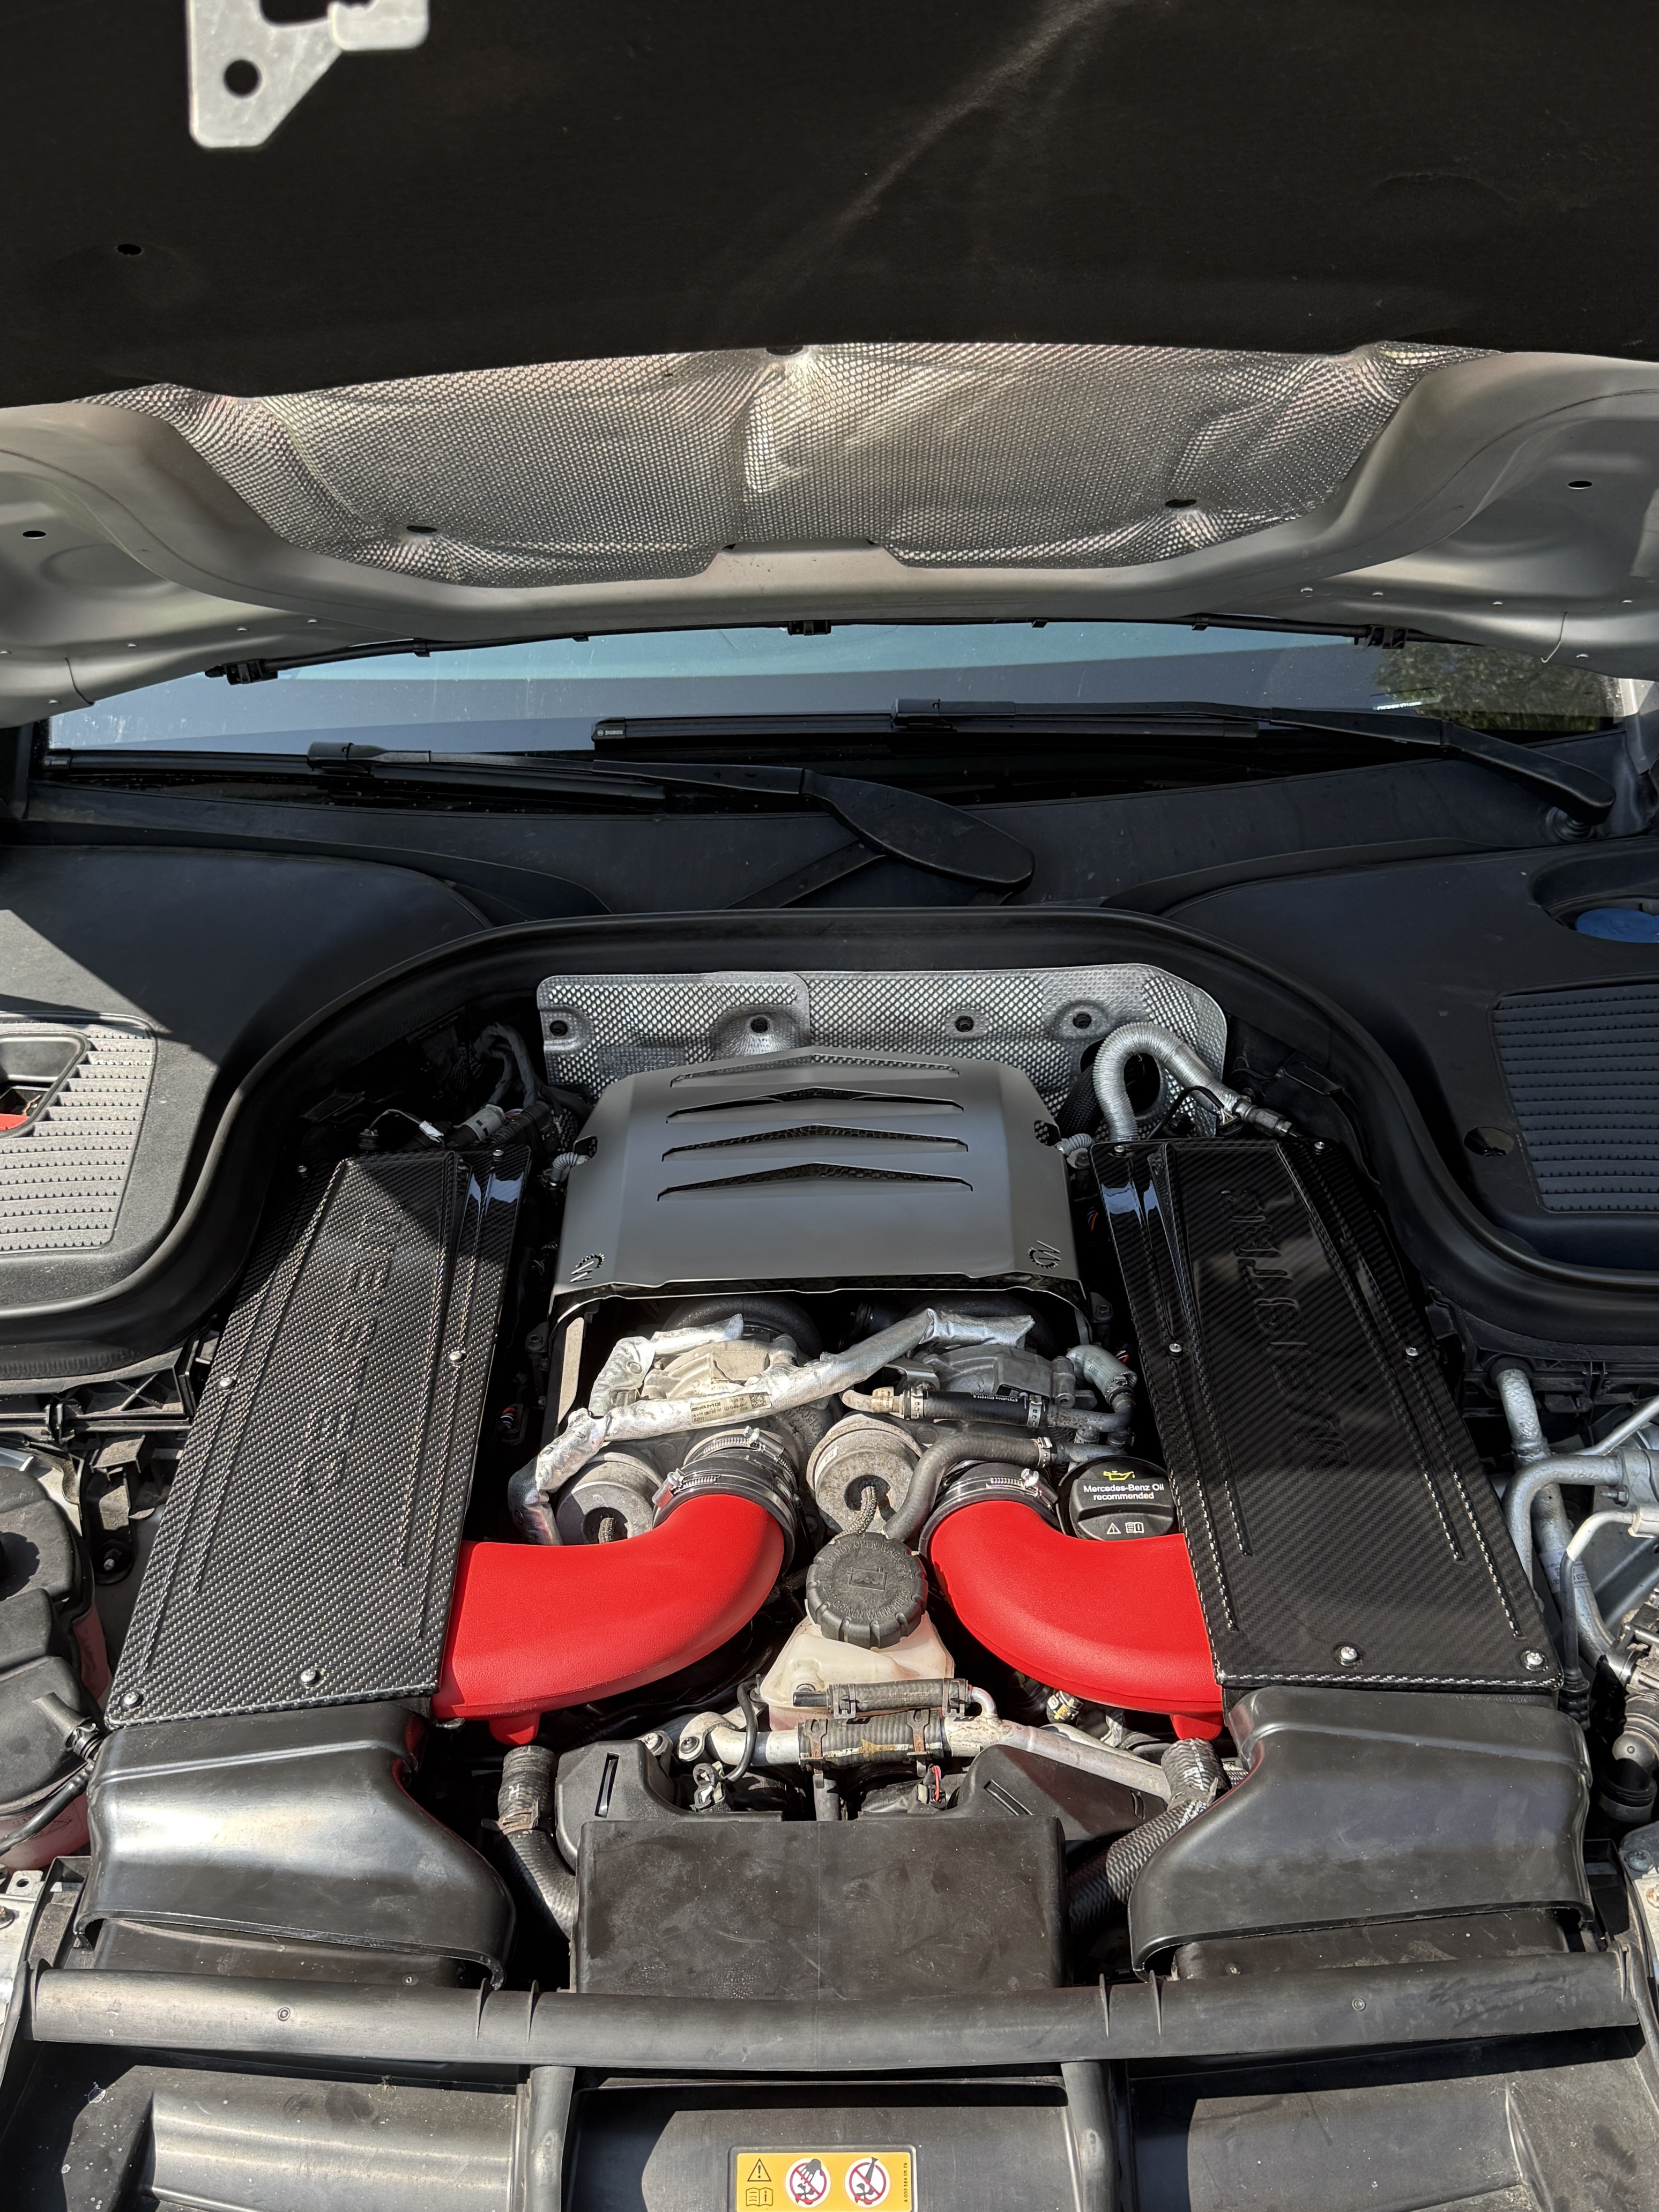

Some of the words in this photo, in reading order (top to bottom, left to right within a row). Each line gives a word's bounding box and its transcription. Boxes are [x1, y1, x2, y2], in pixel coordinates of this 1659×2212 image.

[1083, 1484, 1150, 1493] Mercedes-Benz
[1152, 1484, 1164, 1492] Oil
[1093, 1492, 1154, 1501] recommended
